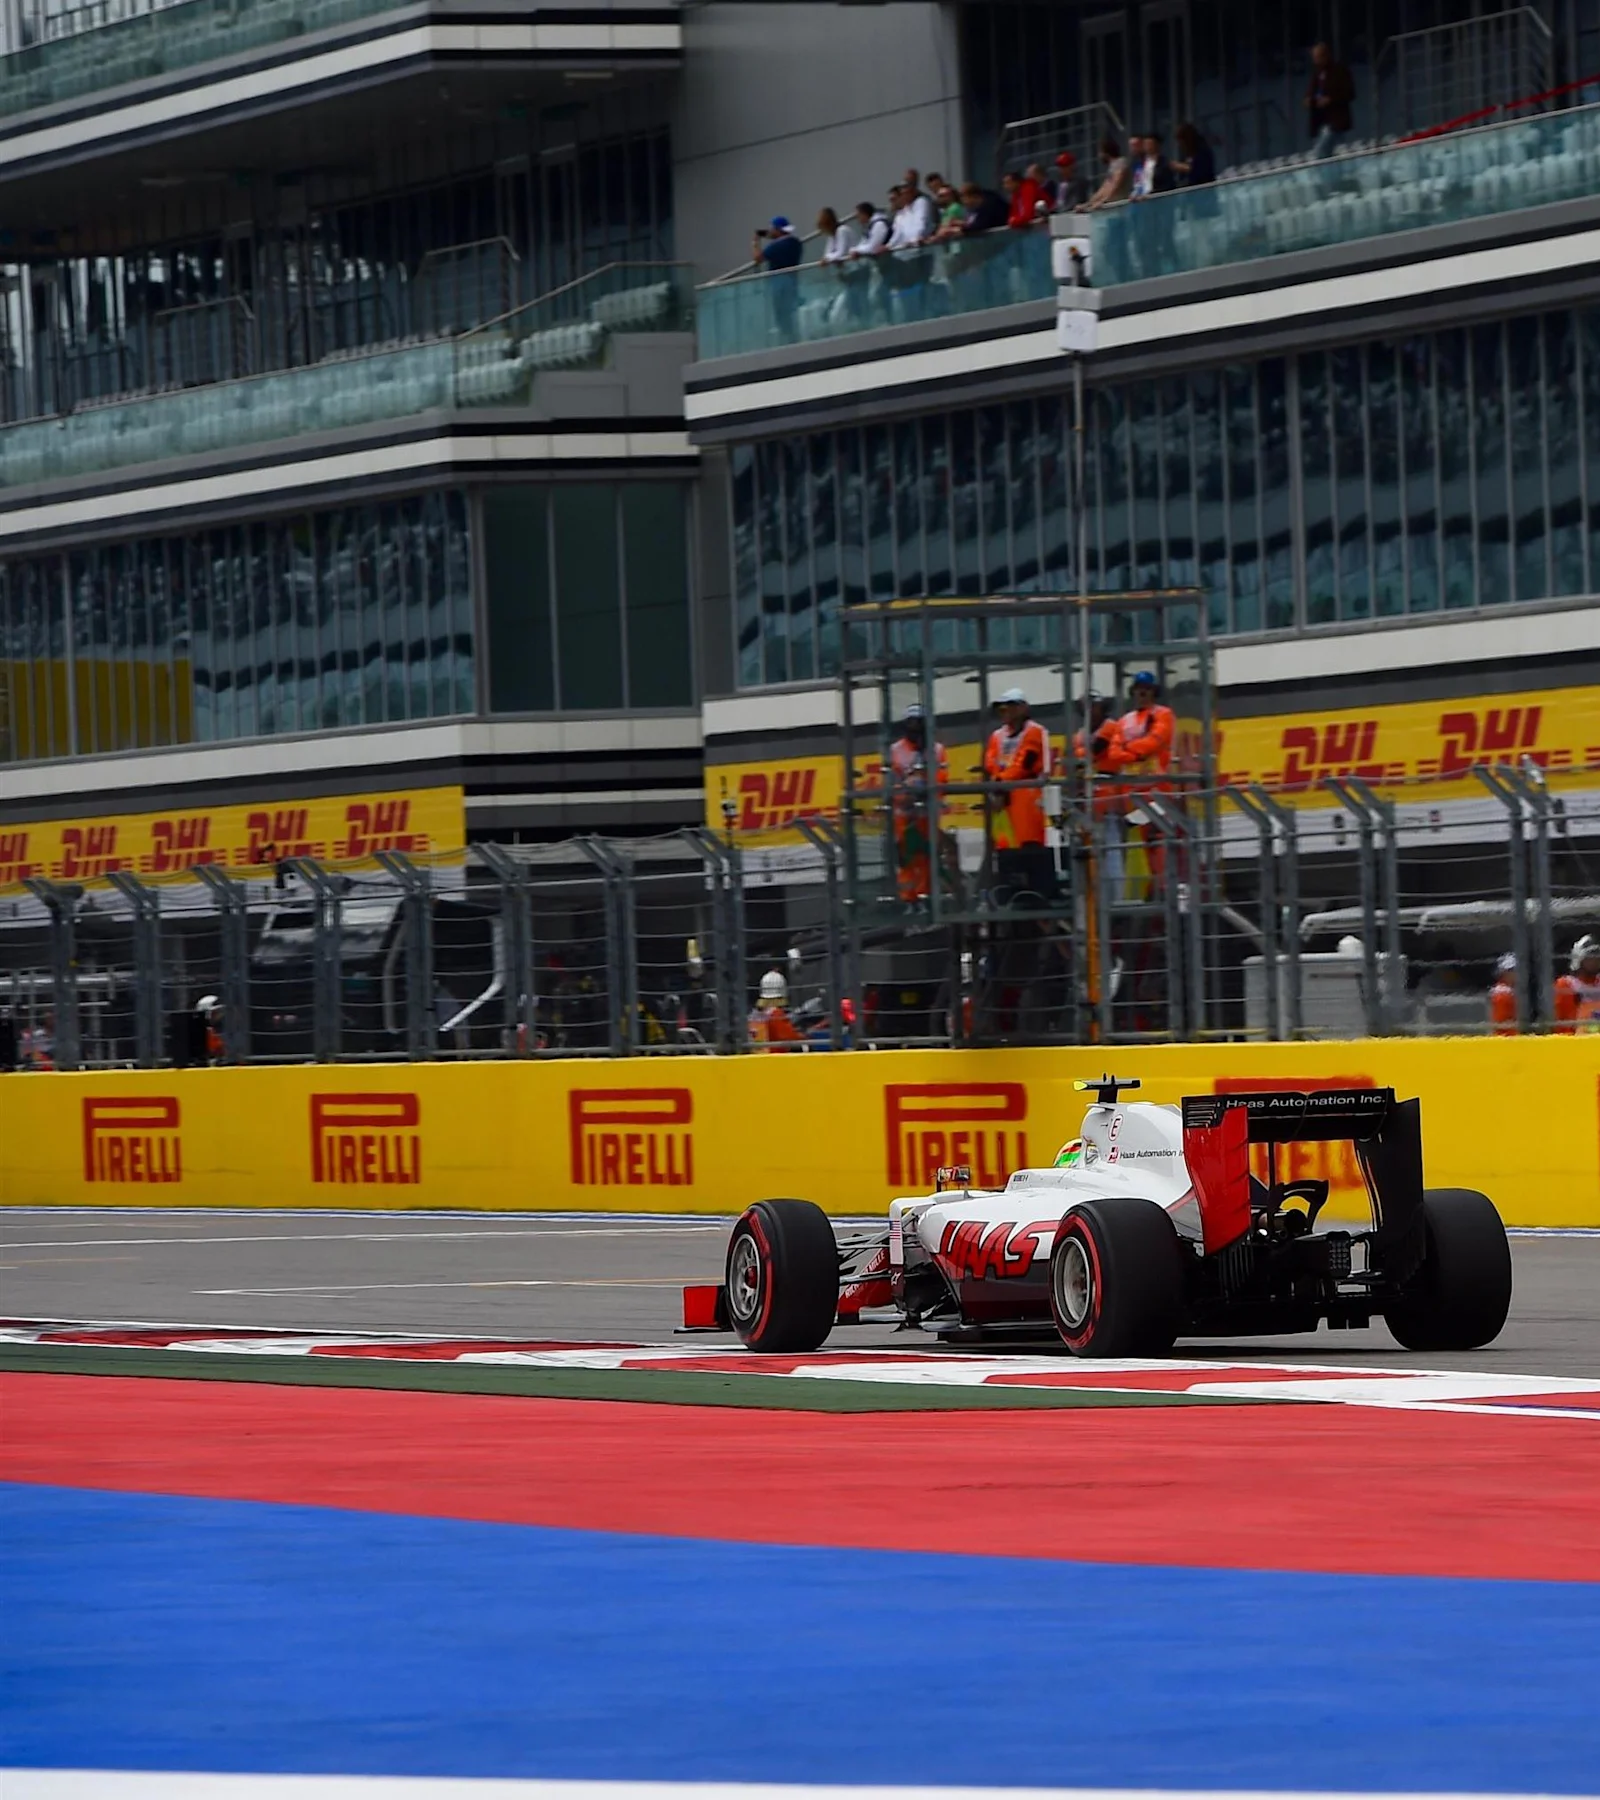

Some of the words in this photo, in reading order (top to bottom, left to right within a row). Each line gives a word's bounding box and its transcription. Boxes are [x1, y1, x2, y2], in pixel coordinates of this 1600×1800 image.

[1282, 721, 1384, 792] DHL
[1439, 706, 1549, 780] DHL
[346, 799, 416, 859] DHL
[739, 769, 818, 830] DHL
[0, 833, 31, 883] HL
[61, 825, 121, 879] DHL
[152, 817, 216, 873] DHL
[246, 809, 311, 864] DHL
[1110, 1117, 1122, 1138] E
[1269, 1096, 1356, 1108] Automation
[1359, 1094, 1386, 1105] Inc.
[83, 1097, 181, 1182] PIRELLI
[310, 1093, 420, 1184] PIRELLI
[570, 1089, 692, 1186] PIRELLI
[884, 1082, 1028, 1186] PIRELLI
[1120, 1150, 1136, 1159] Haas
[1136, 1148, 1177, 1159] Automation
[938, 1219, 1062, 1281] HAAS
